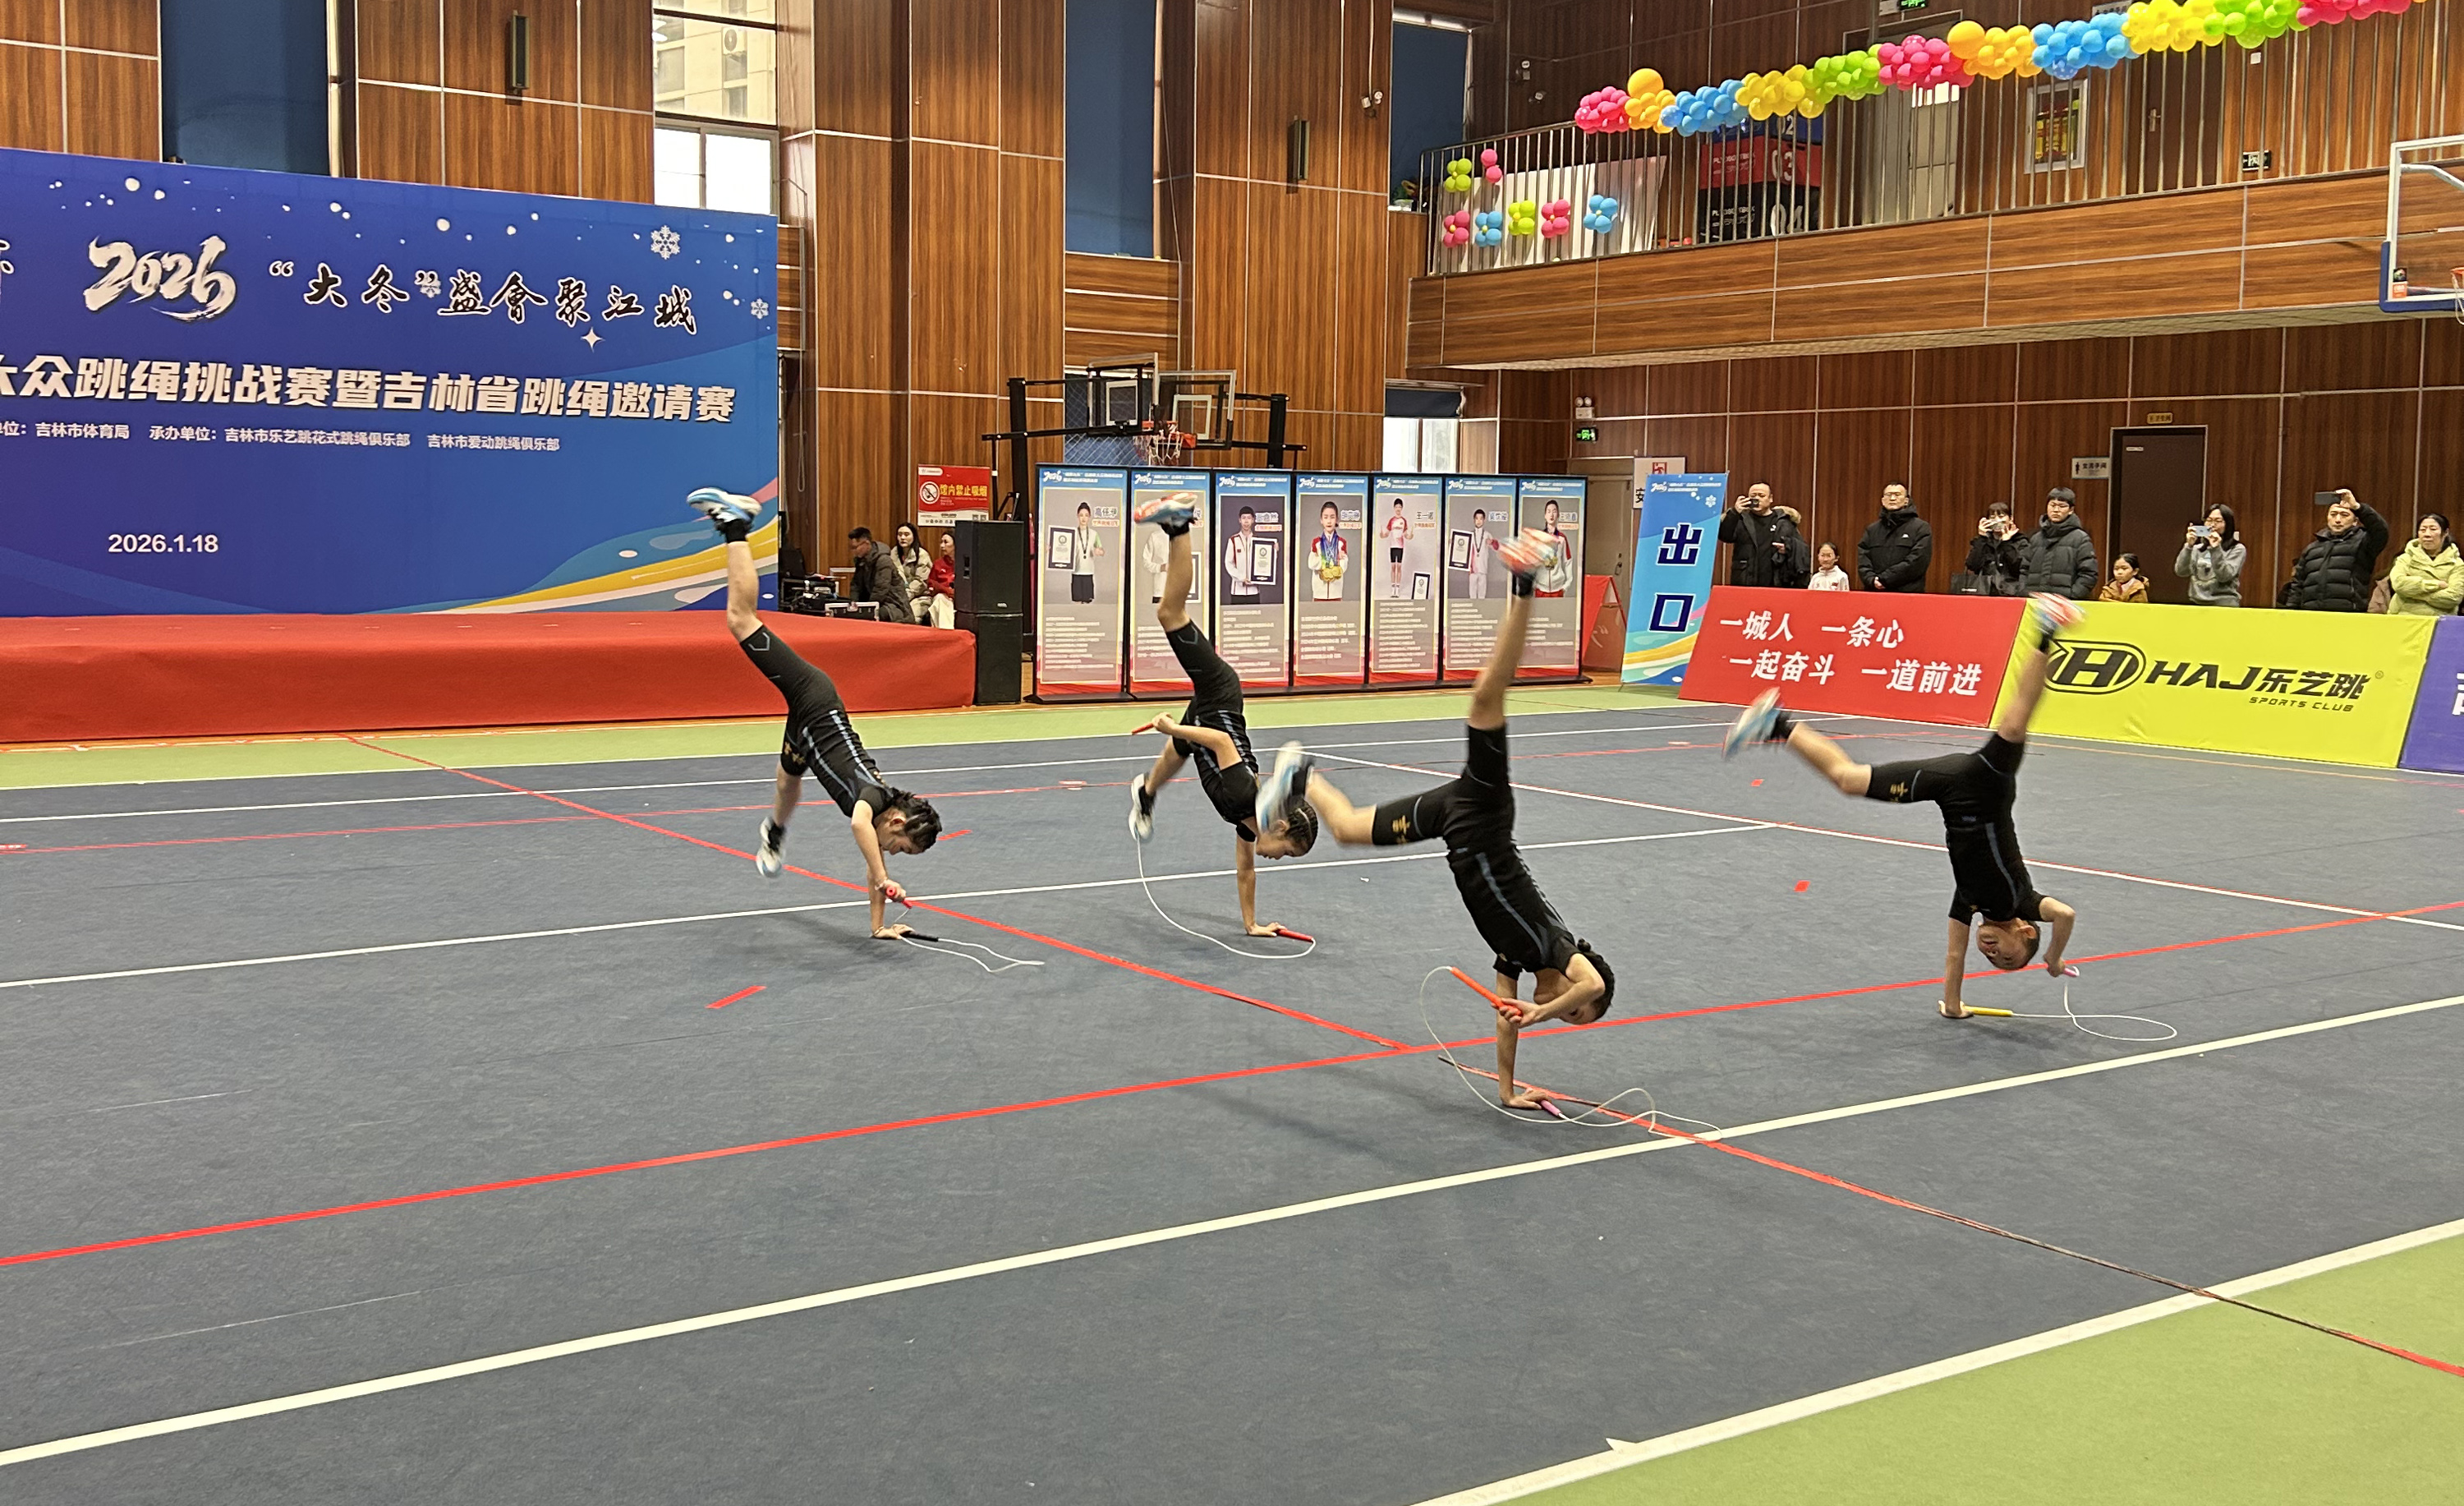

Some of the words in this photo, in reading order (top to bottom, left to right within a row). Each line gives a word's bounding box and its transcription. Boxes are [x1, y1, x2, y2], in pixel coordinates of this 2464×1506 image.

[83, 235, 237, 323] 2026
[427, 434, 560, 452] 吉林市爱动跳绳俱乐部
[940, 483, 988, 497] 馆内禁止吸烟
[108, 533, 219, 553] 2026.1.18
[1648, 523, 1704, 633] 出口
[1720, 610, 1795, 642] 一城人
[1821, 616, 1905, 649] 一条心
[1729, 649, 1836, 685] 一起奋斗
[1861, 659, 1983, 697] 一道前进
[2249, 697, 2308, 708] SPORTS
[2311, 702, 2355, 712] CLUB
